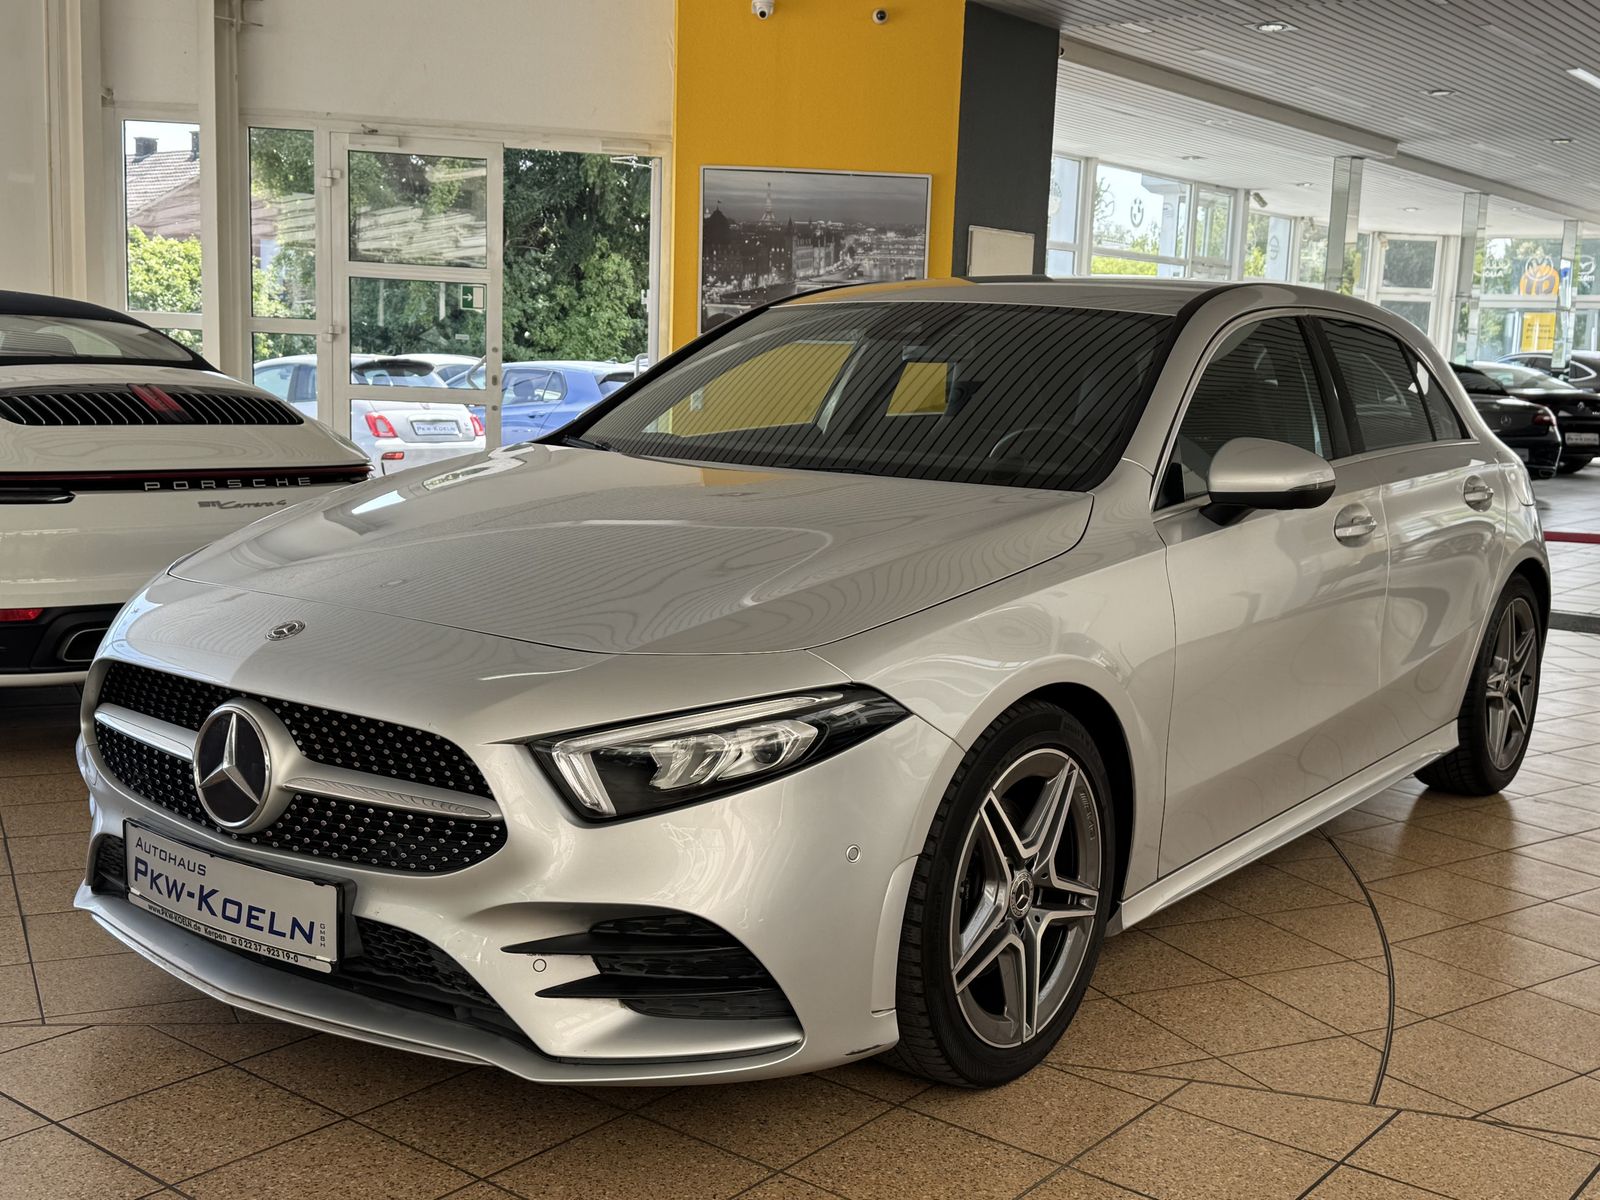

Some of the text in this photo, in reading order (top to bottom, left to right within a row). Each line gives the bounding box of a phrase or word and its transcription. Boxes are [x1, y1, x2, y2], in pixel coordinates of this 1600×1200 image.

[144, 477, 311, 491] PORSCHE
[135, 837, 207, 876] AUTOHAUS
[134, 857, 315, 944] PKW-KOELN
[204, 928, 227, 942] Kerpen
